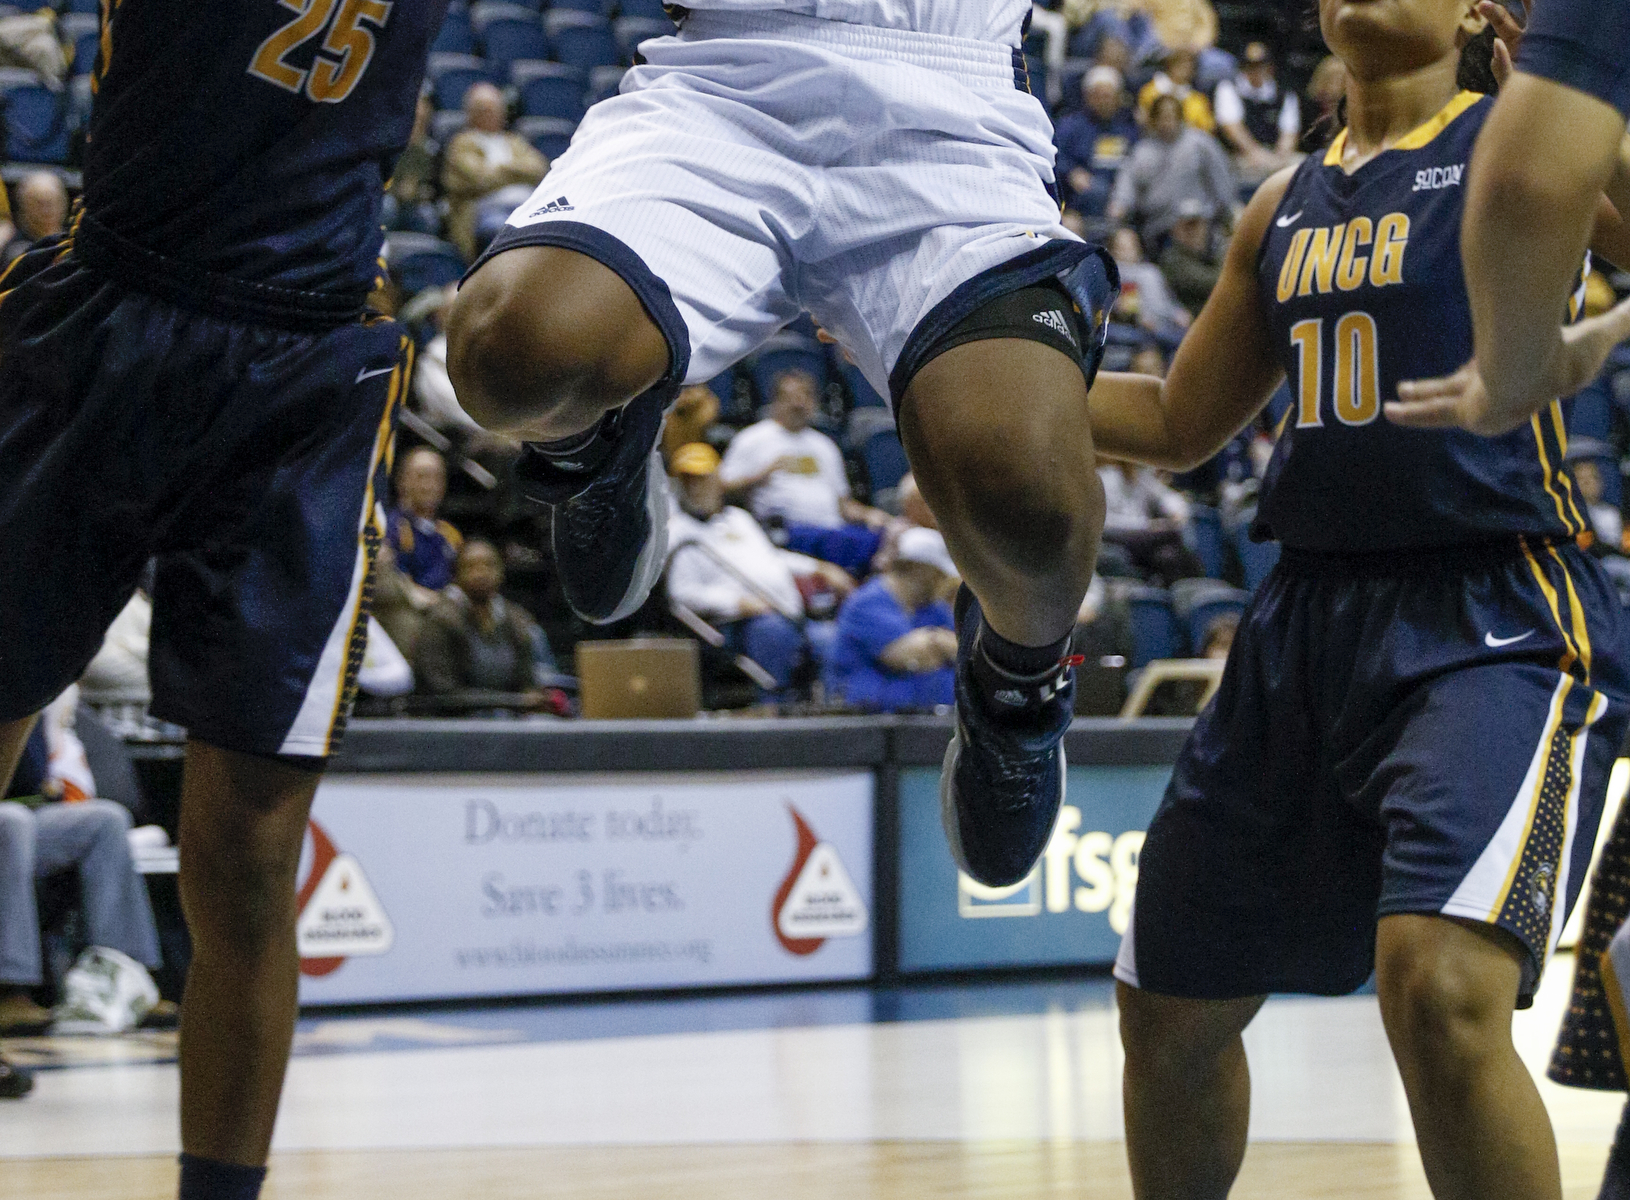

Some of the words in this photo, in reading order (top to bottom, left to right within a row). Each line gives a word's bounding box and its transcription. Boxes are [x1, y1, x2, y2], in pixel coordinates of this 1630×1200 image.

[1276, 212, 1410, 303] UNCG
[1290, 310, 1381, 429] 10
[464, 798, 597, 846] Donate
[480, 869, 565, 920] Save
